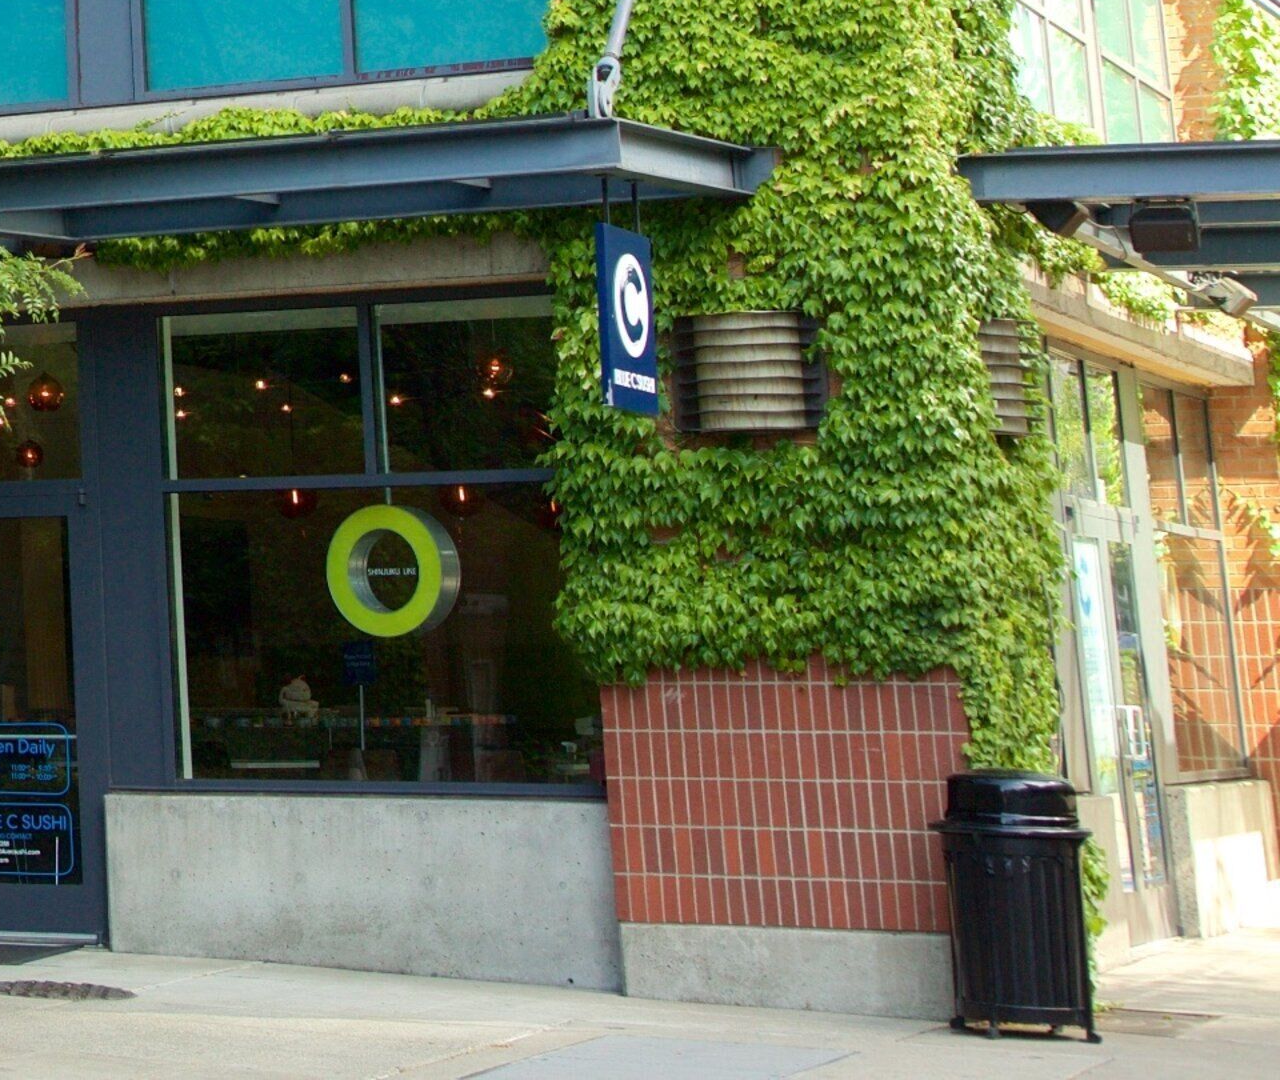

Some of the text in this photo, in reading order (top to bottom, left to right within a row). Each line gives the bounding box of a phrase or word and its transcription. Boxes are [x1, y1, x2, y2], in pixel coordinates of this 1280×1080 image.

[18, 737, 56, 759] Daily
[6, 814, 18, 829] C
[22, 814, 67, 830] SUSHI
